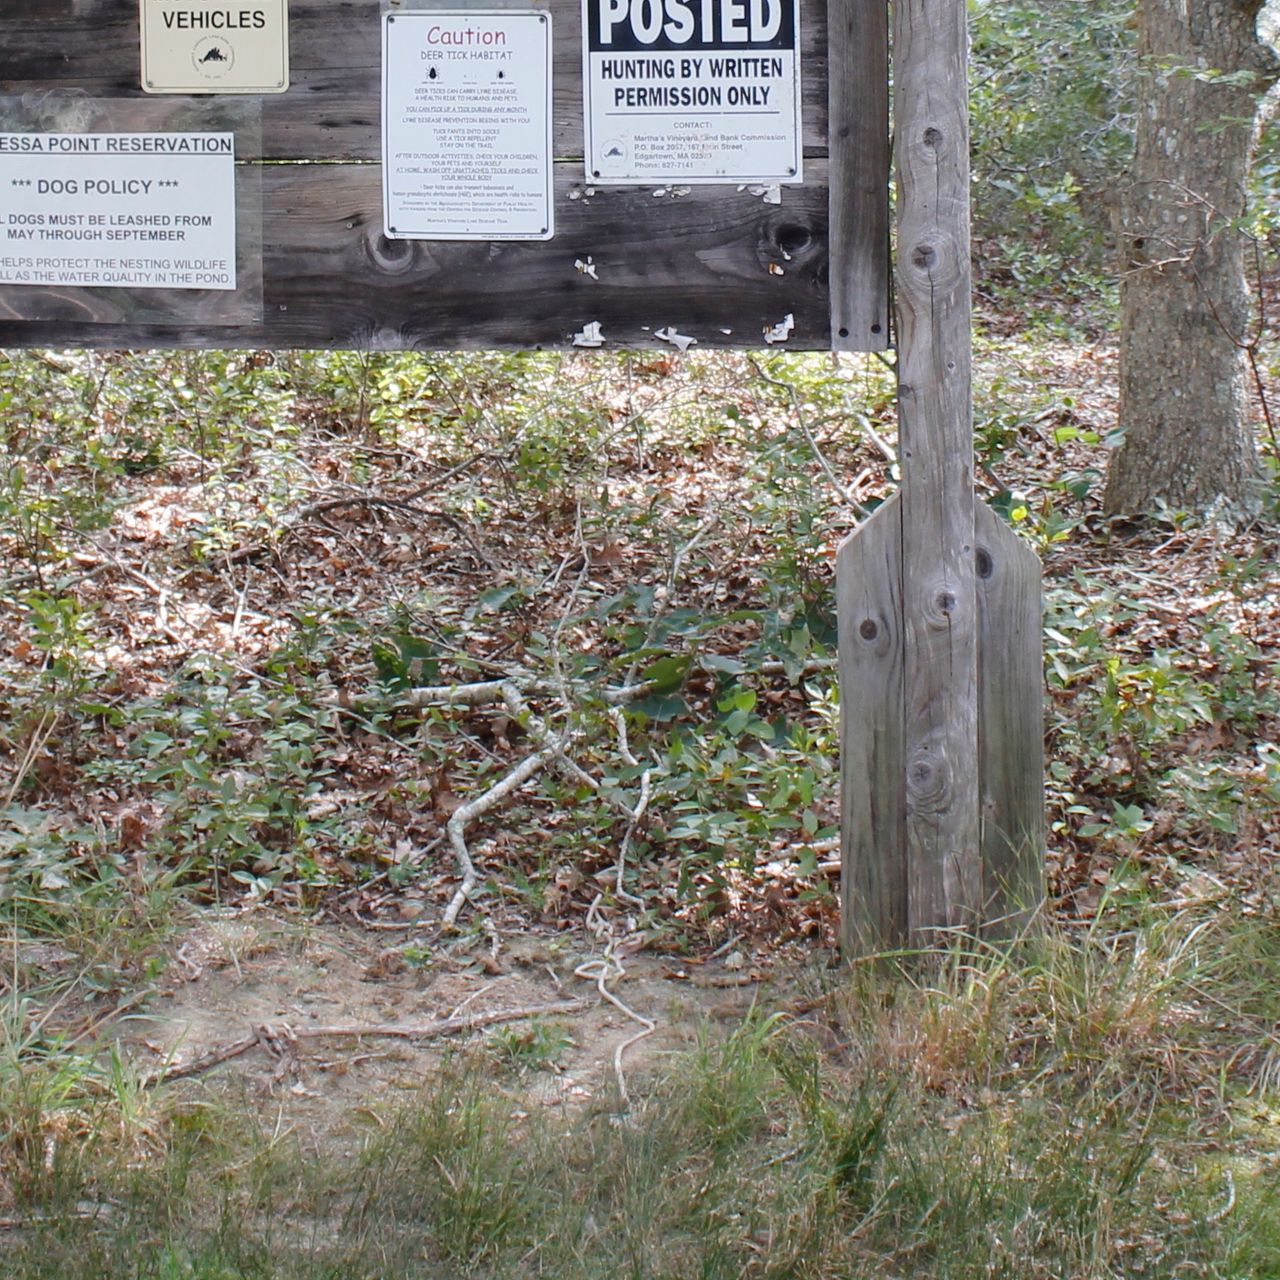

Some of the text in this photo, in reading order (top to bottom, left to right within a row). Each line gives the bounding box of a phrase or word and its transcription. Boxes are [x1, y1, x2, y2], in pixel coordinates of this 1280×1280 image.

[163, 11, 266, 28] VEHICLES
[427, 26, 507, 45] Caution
[420, 51, 513, 60] DEER TICK HABITAT
[601, 58, 783, 79] HUNTING BY WRITTEN
[614, 86, 770, 107] PERMISSION ONLY
[48, 137, 100, 151] POINT
[106, 138, 232, 152] RESERVATION
[38, 179, 151, 196] DOG POLICY
[8, 214, 45, 225] DOGS
[49, 214, 83, 226] MUST
[88, 214, 106, 226] BE
[110, 214, 171, 226] LEASHED
[174, 215, 212, 227] FROM
[7, 229, 185, 241] MAY THROUGH SEPTEMBER
[36, 257, 89, 269] PROTECT
[94, 258, 117, 269] THE
[119, 258, 171, 270] NESTING
[174, 259, 227, 270] WILDLIFE
[15, 270, 30, 281] AS
[34, 270, 55, 282] THE
[58, 270, 101, 282] WATER
[102, 271, 152, 283] QUALITY
[155, 271, 167, 283] IN
[168, 272, 193, 283] THE
